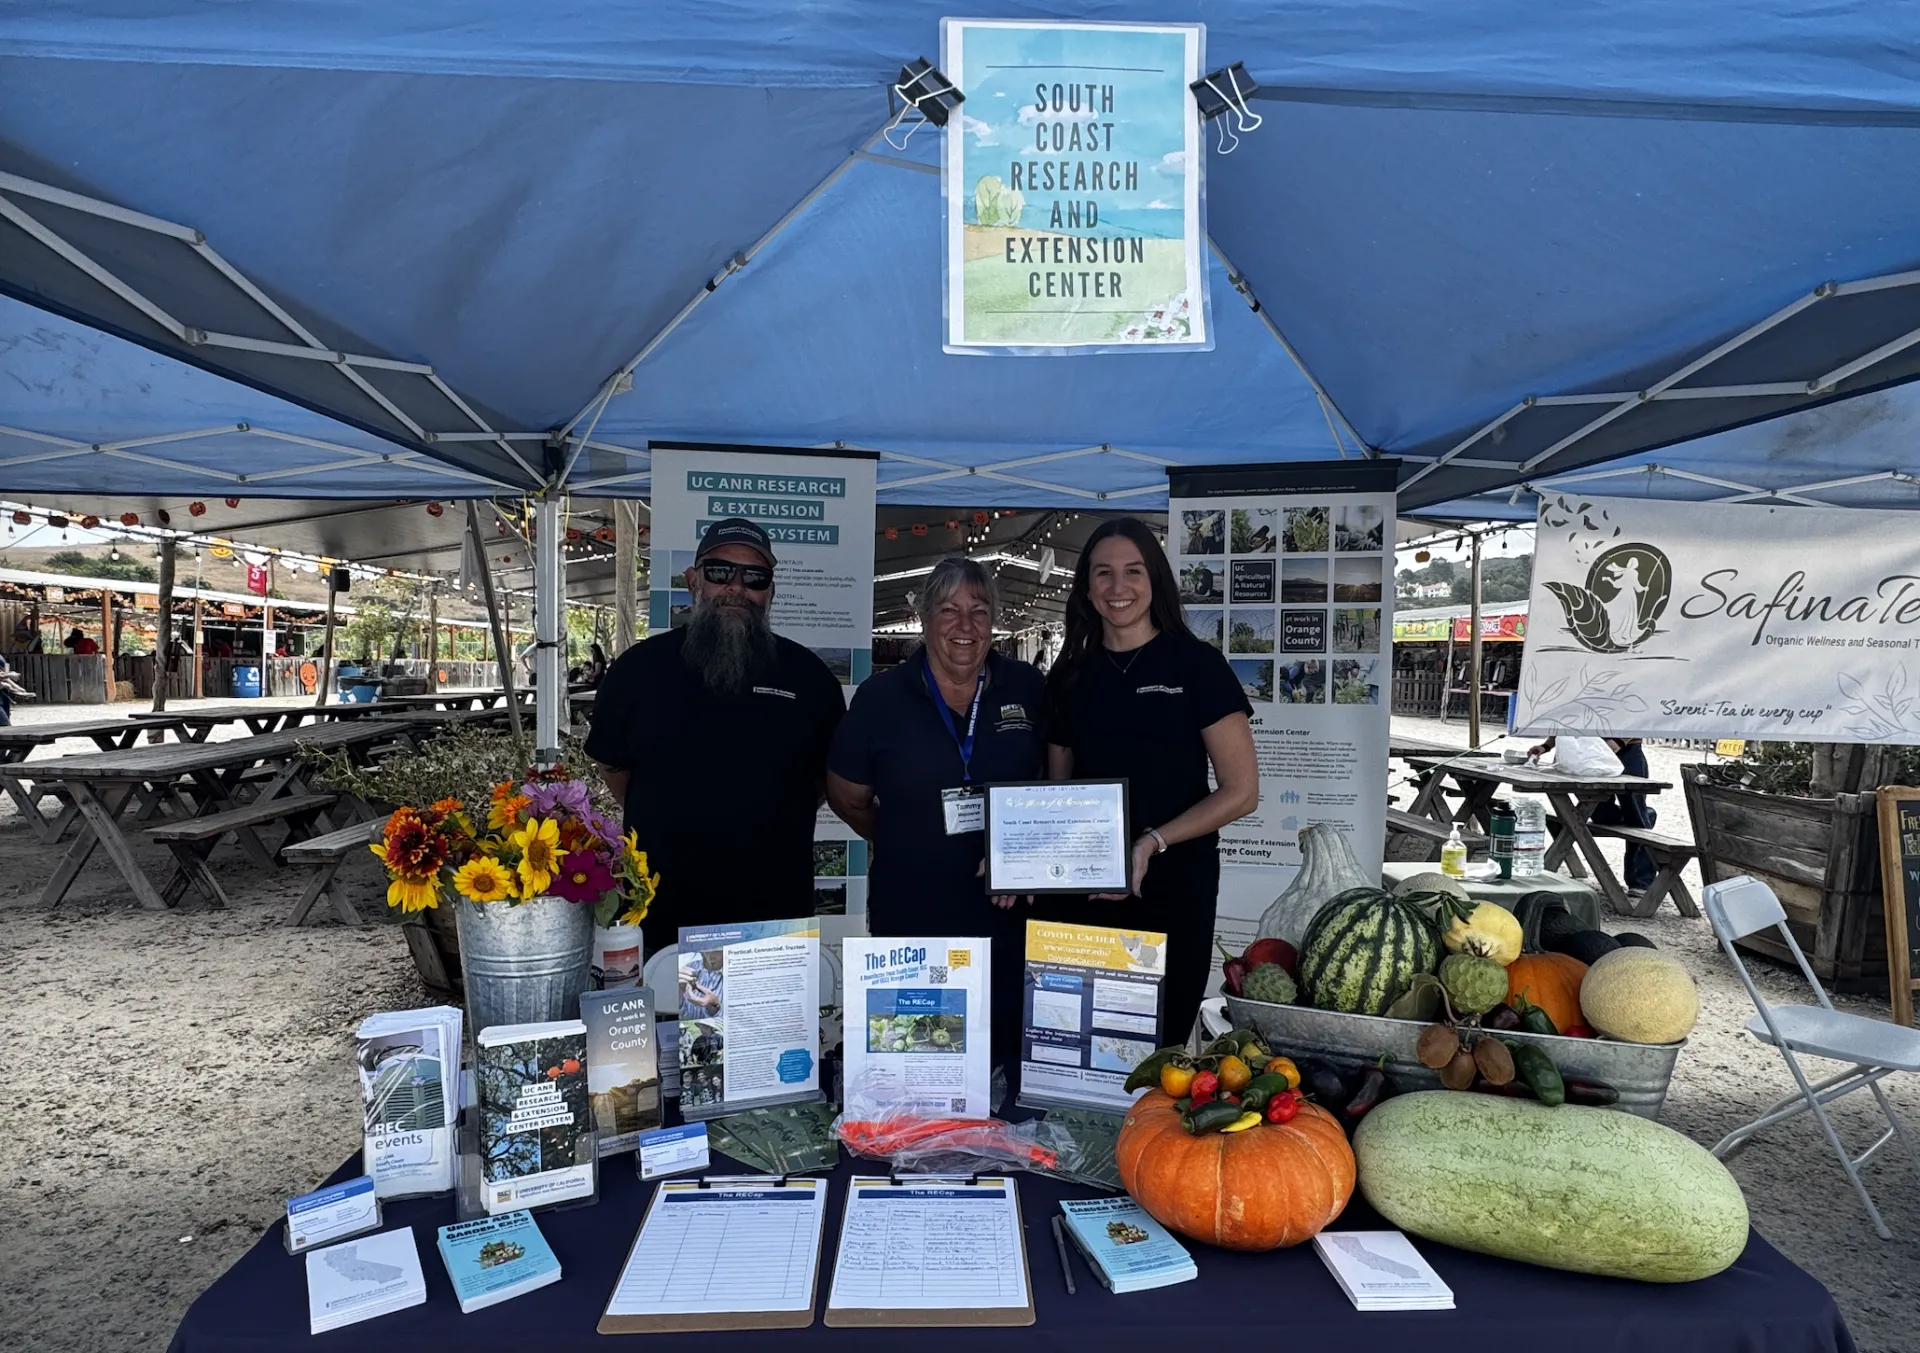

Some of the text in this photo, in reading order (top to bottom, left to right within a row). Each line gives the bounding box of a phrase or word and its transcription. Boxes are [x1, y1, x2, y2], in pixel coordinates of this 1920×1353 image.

[1035, 84, 1114, 113] SOUTH
[1036, 123, 1114, 152] COAST
[1011, 162, 1138, 190] RESEARCH
[1050, 201, 1098, 228] AND
[1007, 237, 1144, 264] EXTENSION
[1029, 272, 1122, 297] CENTER
[692, 477, 840, 494] UC ANR RESEARCH
[712, 502, 819, 517] & EXTENSION
[768, 528, 830, 541] SYSTEM
[1286, 626, 1320, 635] Orange
[1286, 637, 1320, 646] County
[1766, 635, 1803, 647] Organic
[1807, 636, 1845, 647] Wellness
[1848, 637, 1864, 646] and
[1866, 638, 1911, 649] Seasonal
[1660, 700, 1832, 725] "Sereni-Tea in every cup"
[1718, 742, 1743, 752] ENTER
[1260, 839, 1296, 847] Extension
[1216, 848, 1272, 858] ange County
[1077, 932, 1116, 944] CACHER
[754, 946, 783, 954] Connected.
[865, 946, 926, 970] The RECap
[1048, 954, 1106, 967] CoyoteCacher
[603, 999, 645, 1015] UC ANR
[608, 1023, 646, 1036] Orange
[611, 1037, 648, 1051] County
[524, 1084, 553, 1095] UC ANR
[519, 1095, 560, 1106] RESEARCH
[521, 1106, 565, 1117] EXTENSION
[375, 1121, 405, 1135] REC
[508, 1116, 571, 1131] CENTER SYSTEM
[375, 1134, 422, 1150] events
[520, 1184, 548, 1194] UNIVERSITY
[556, 1177, 585, 1186] CALIFORNIA
[445, 1225, 495, 1240] GARDEN
[499, 1217, 528, 1227] EXPO
[446, 1220, 488, 1232] URBAN
